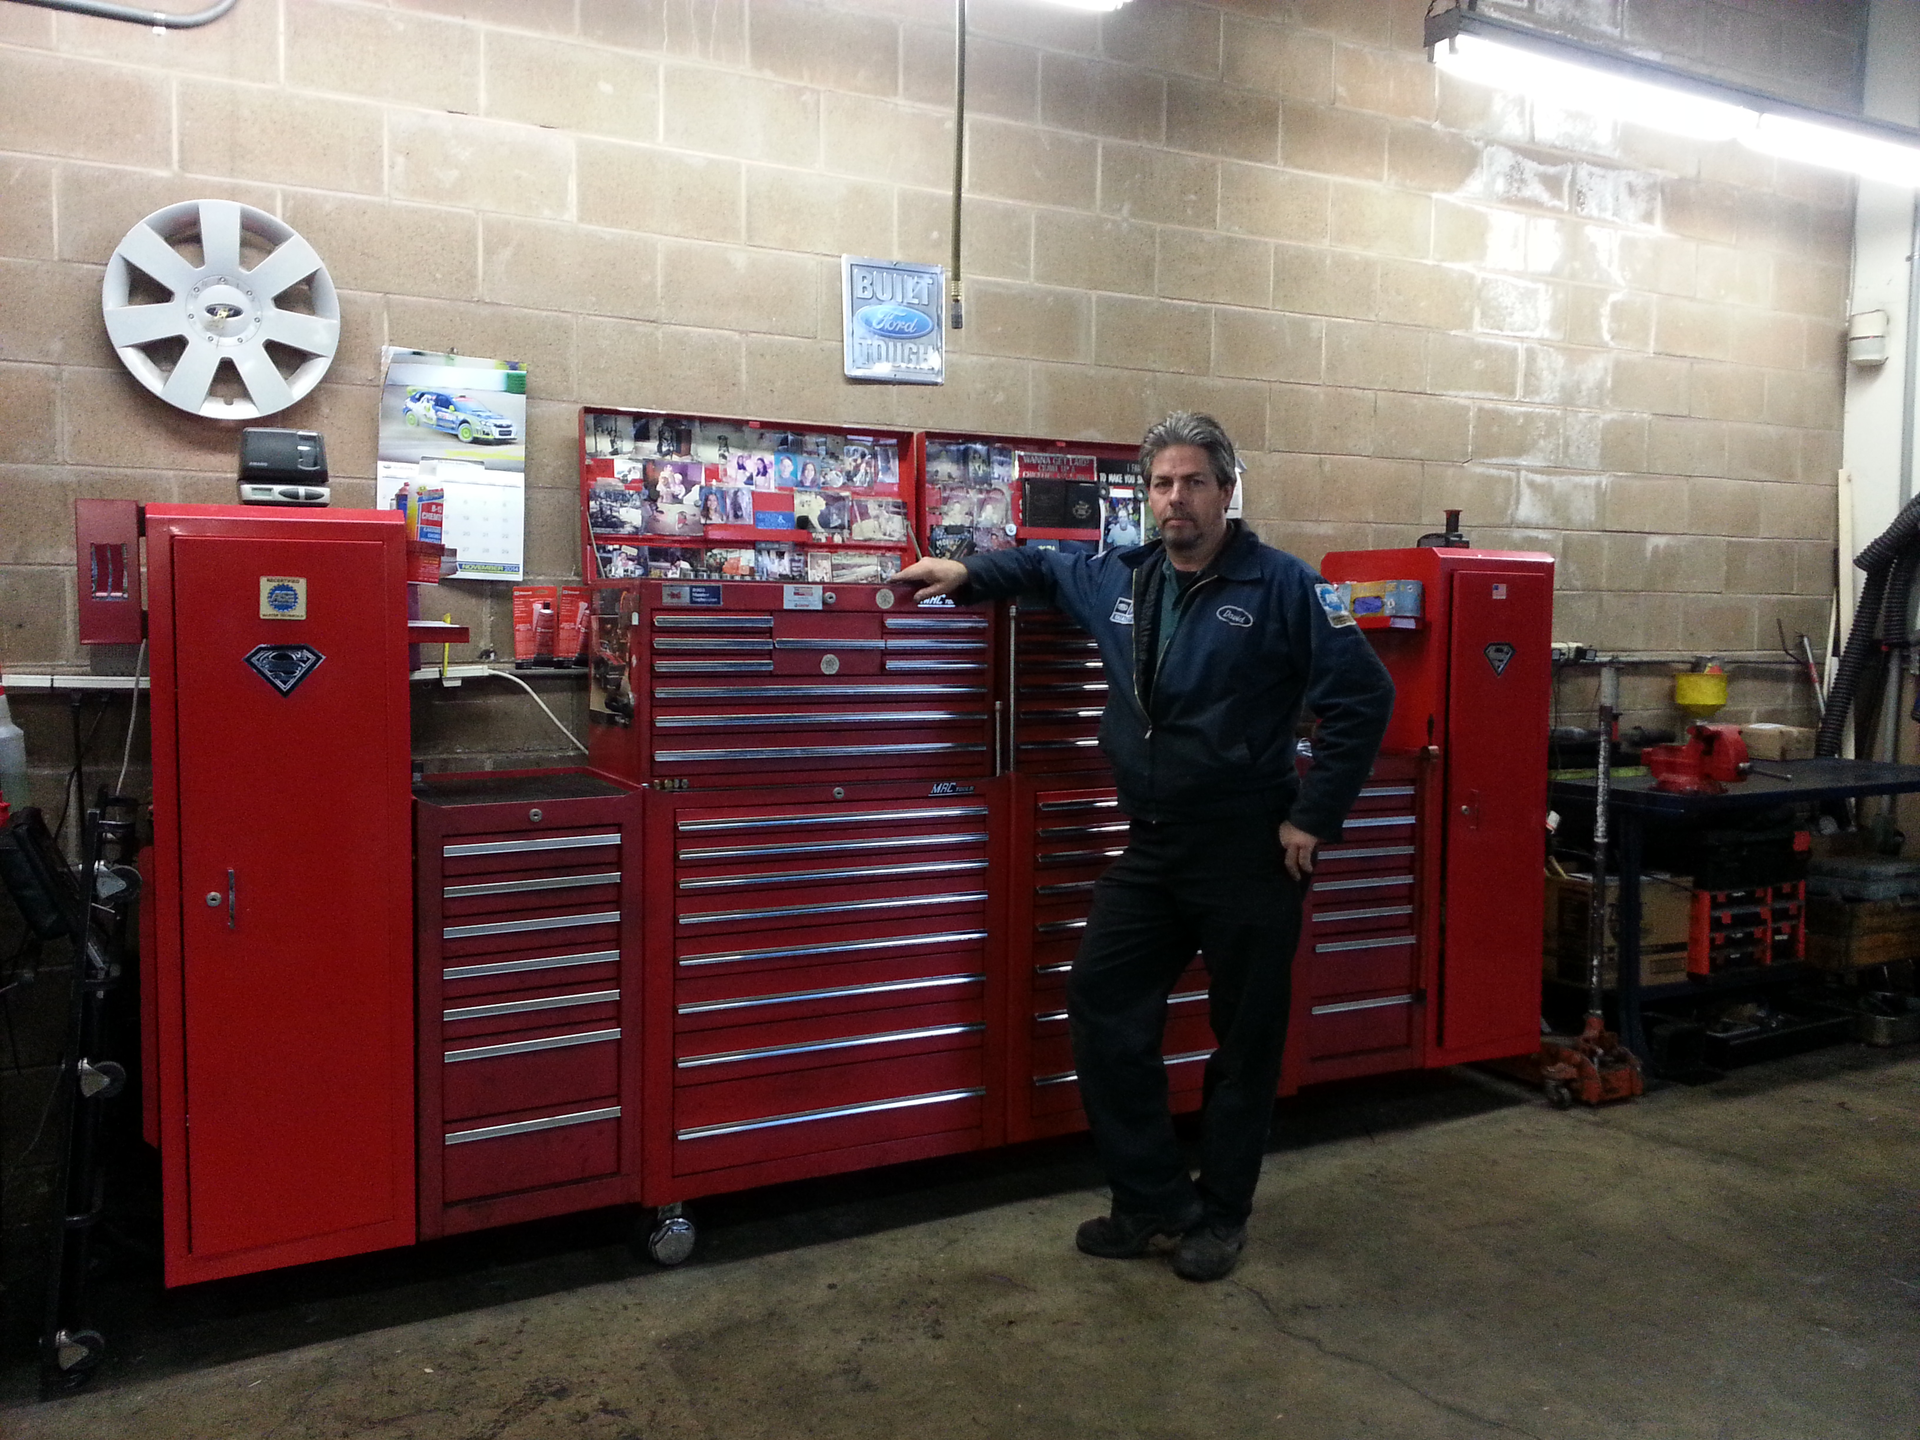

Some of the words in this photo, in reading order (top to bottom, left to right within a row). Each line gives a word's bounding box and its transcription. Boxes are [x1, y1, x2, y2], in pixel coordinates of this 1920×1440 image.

[854, 269, 934, 306] BUILT
[873, 309, 918, 332] Ford
[858, 339, 935, 370] TOUGH
[1023, 456, 1050, 464] WANNA
[1053, 457, 1067, 465] GET
[1099, 473, 1107, 482] TO
[1108, 473, 1123, 484] MAKE
[1125, 474, 1135, 484] YOU
[778, 515, 786, 523] &
[1223, 610, 1246, 623] David
[931, 782, 956, 793] MAC
